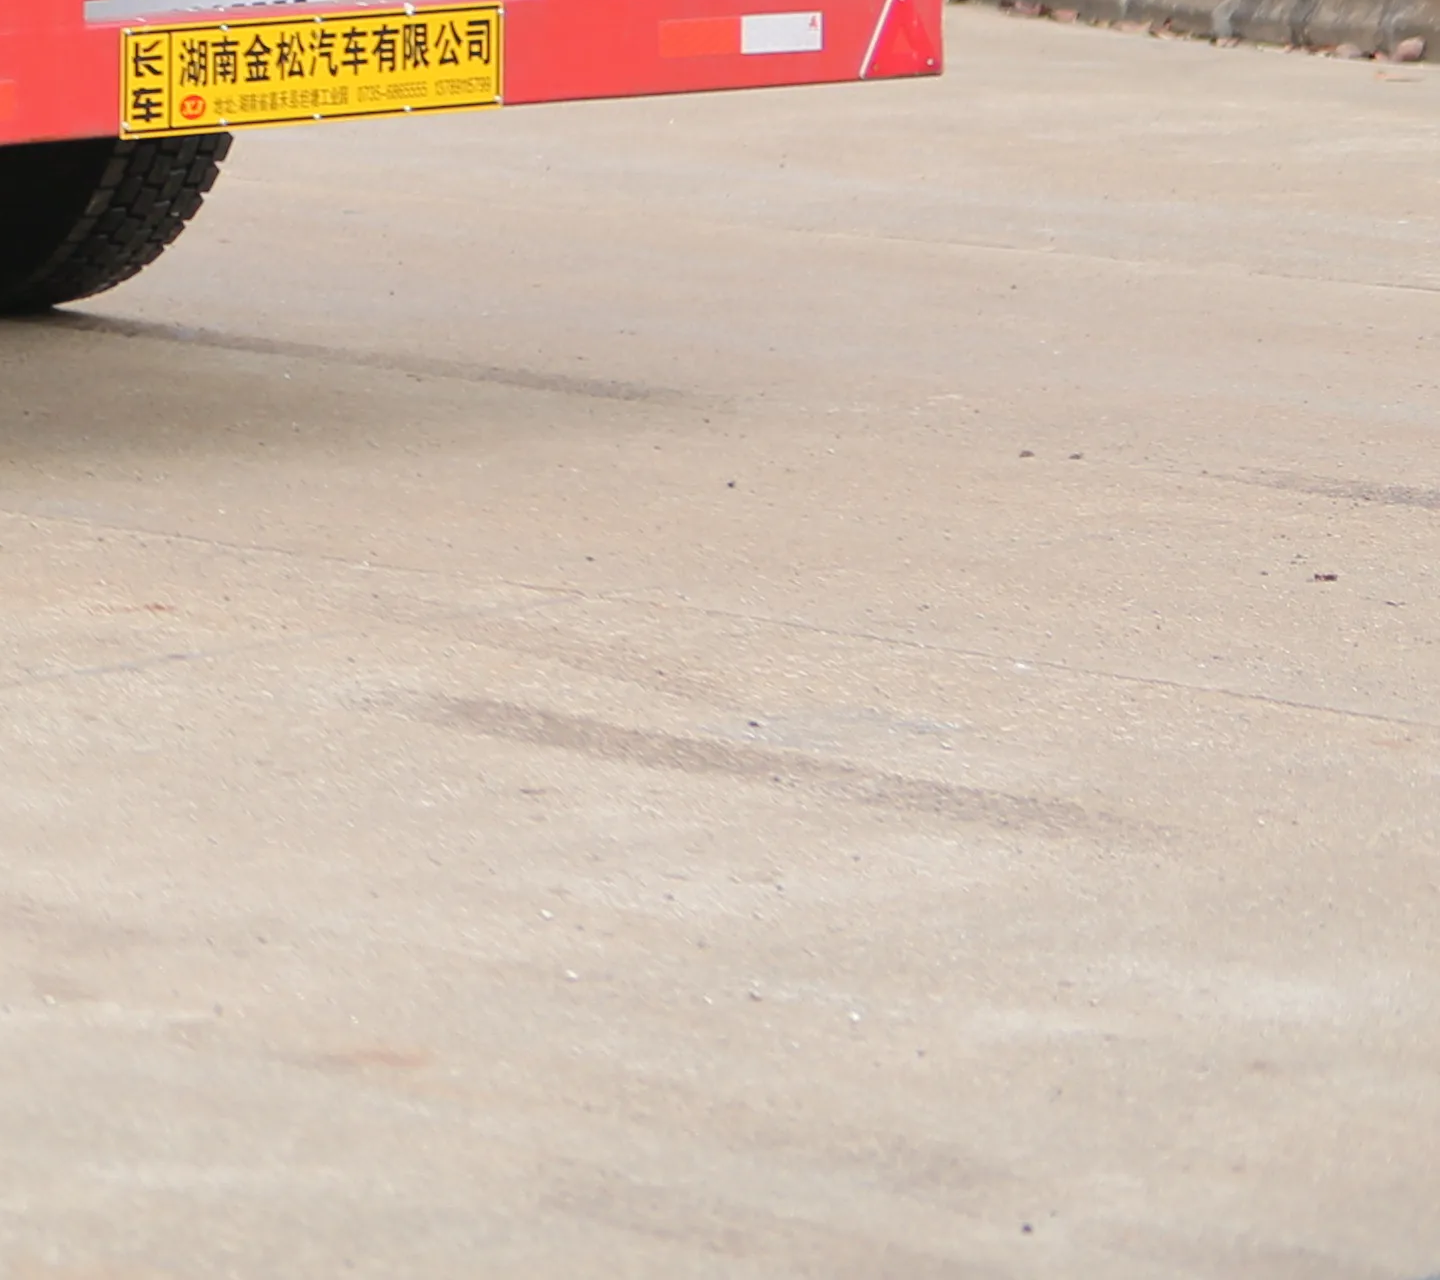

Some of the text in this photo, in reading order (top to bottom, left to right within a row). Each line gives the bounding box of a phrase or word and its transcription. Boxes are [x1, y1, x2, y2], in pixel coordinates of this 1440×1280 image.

[178, 19, 492, 88] 湖南金松汽车有限公司
